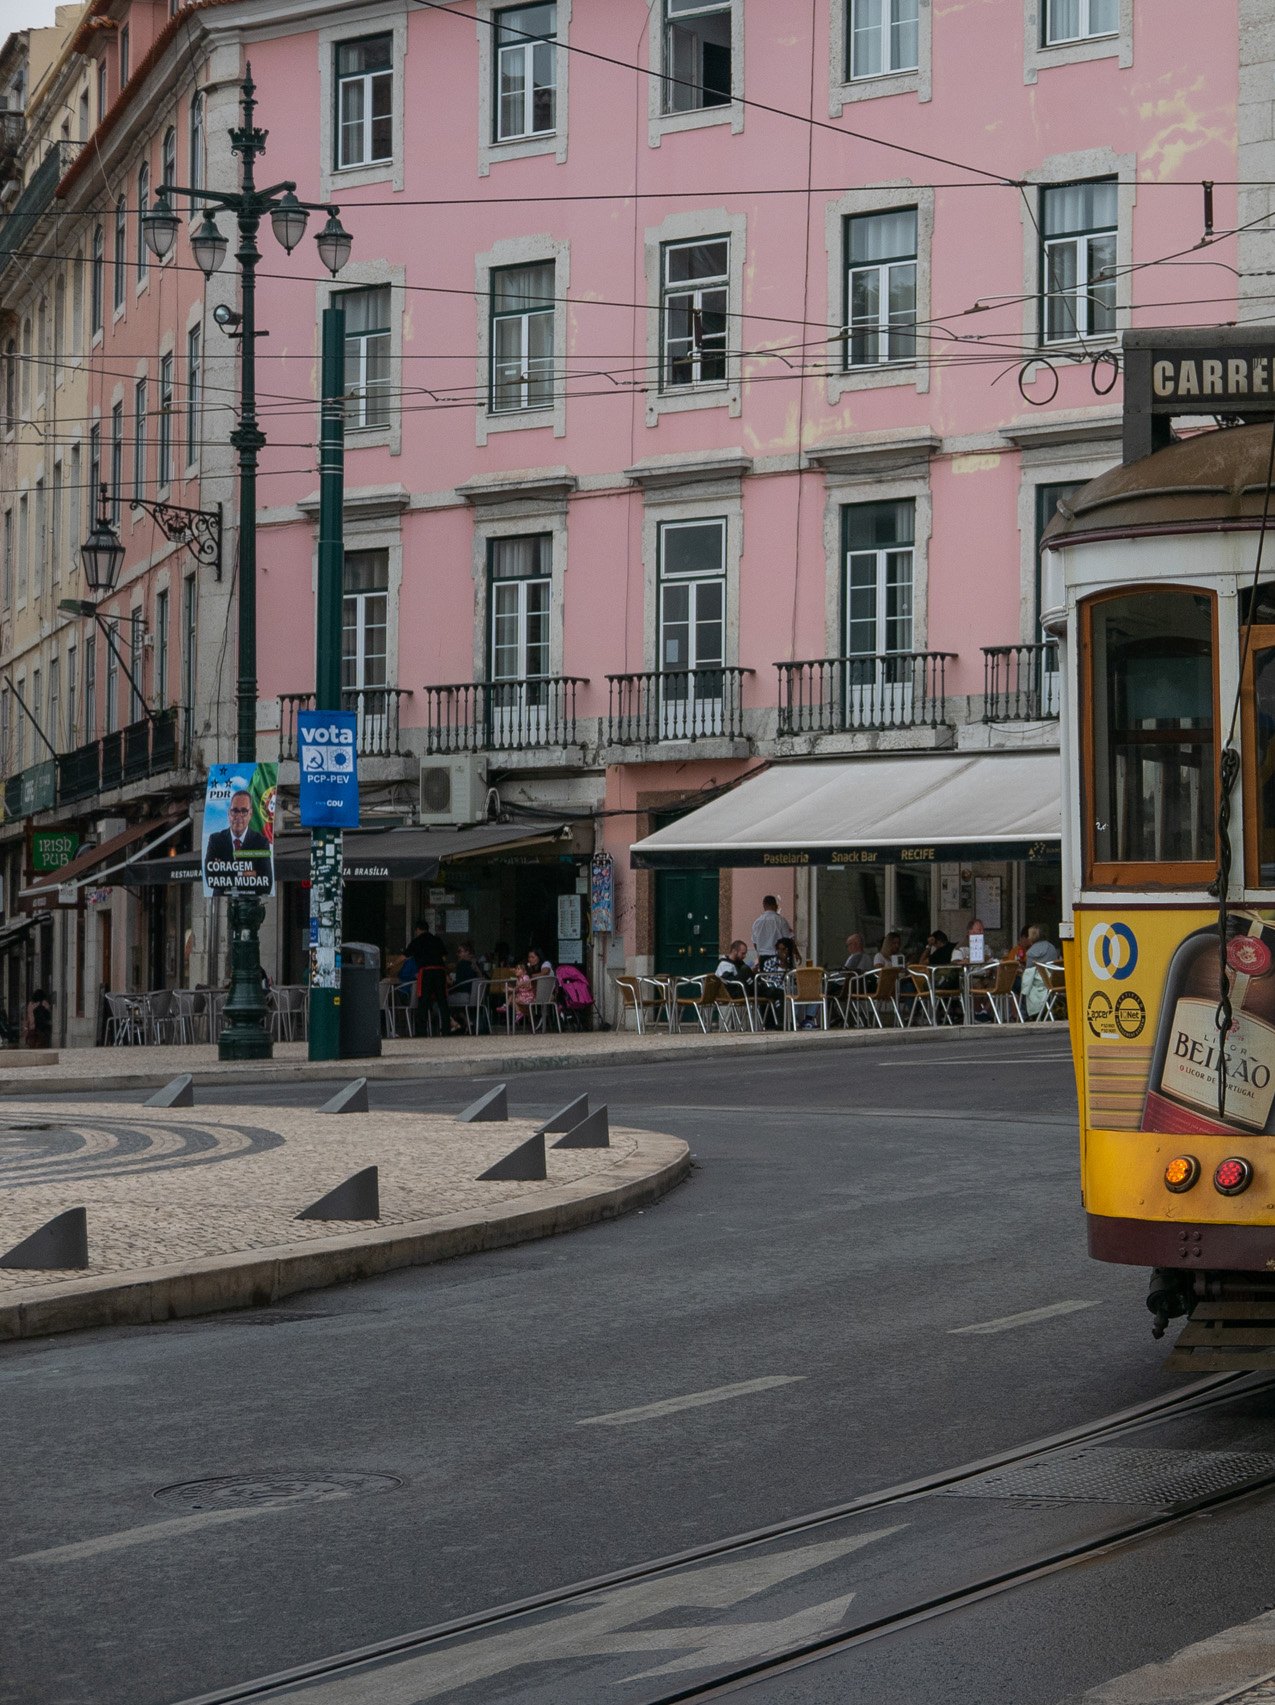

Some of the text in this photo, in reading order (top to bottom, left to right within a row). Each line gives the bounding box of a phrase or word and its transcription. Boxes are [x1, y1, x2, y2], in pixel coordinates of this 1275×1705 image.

[300, 725, 354, 744] vota
[307, 774, 350, 784] PCP-PEV
[209, 790, 231, 799] PDR
[326, 799, 344, 807] CDU
[39, 836, 73, 852] IRISH
[43, 852, 69, 867] PUB
[763, 848, 936, 865] Pastelaria Snack Bar RECIFE
[207, 861, 253, 872] CORAGEM
[355, 865, 389, 876] BRASÍLIA
[208, 876, 270, 887] PARA MUDAR
[1203, 1034, 1248, 1055] LIOR
[1173, 1031, 1271, 1088] BEIRÃO
[1185, 1066, 1205, 1080] LICOR
[1206, 1075, 1217, 1084] DE
